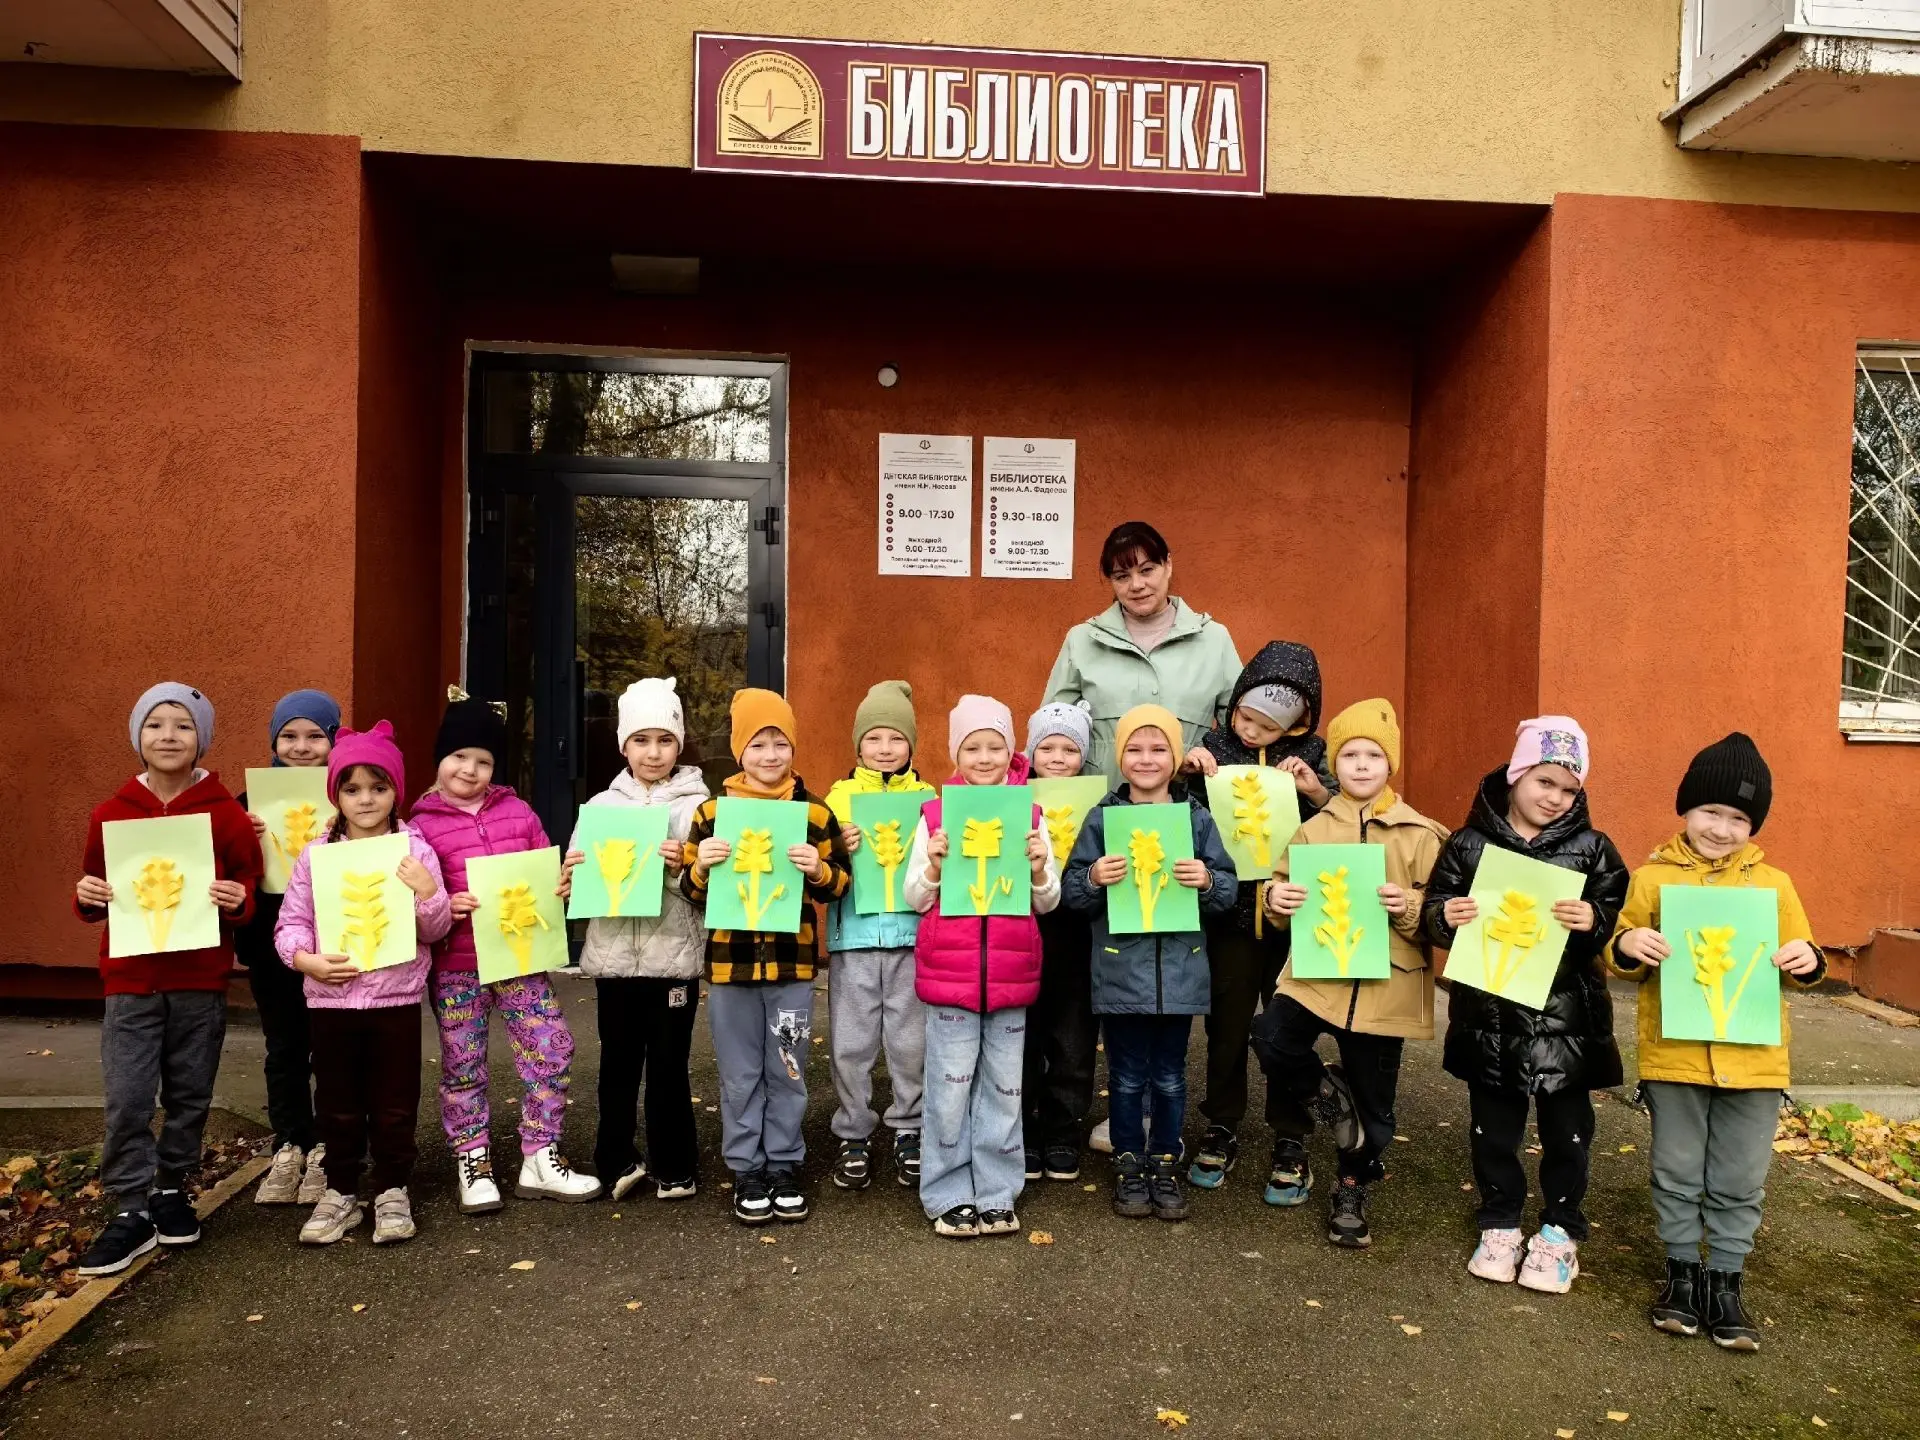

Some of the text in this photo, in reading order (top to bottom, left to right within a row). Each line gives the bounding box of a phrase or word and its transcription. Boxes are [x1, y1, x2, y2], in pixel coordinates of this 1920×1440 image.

[848, 66, 1243, 172] БИБЛИОТЕКА
[918, 473, 968, 482] БИБЛИОТЕКА
[990, 473, 1067, 484] БИБЛИОТЕКА
